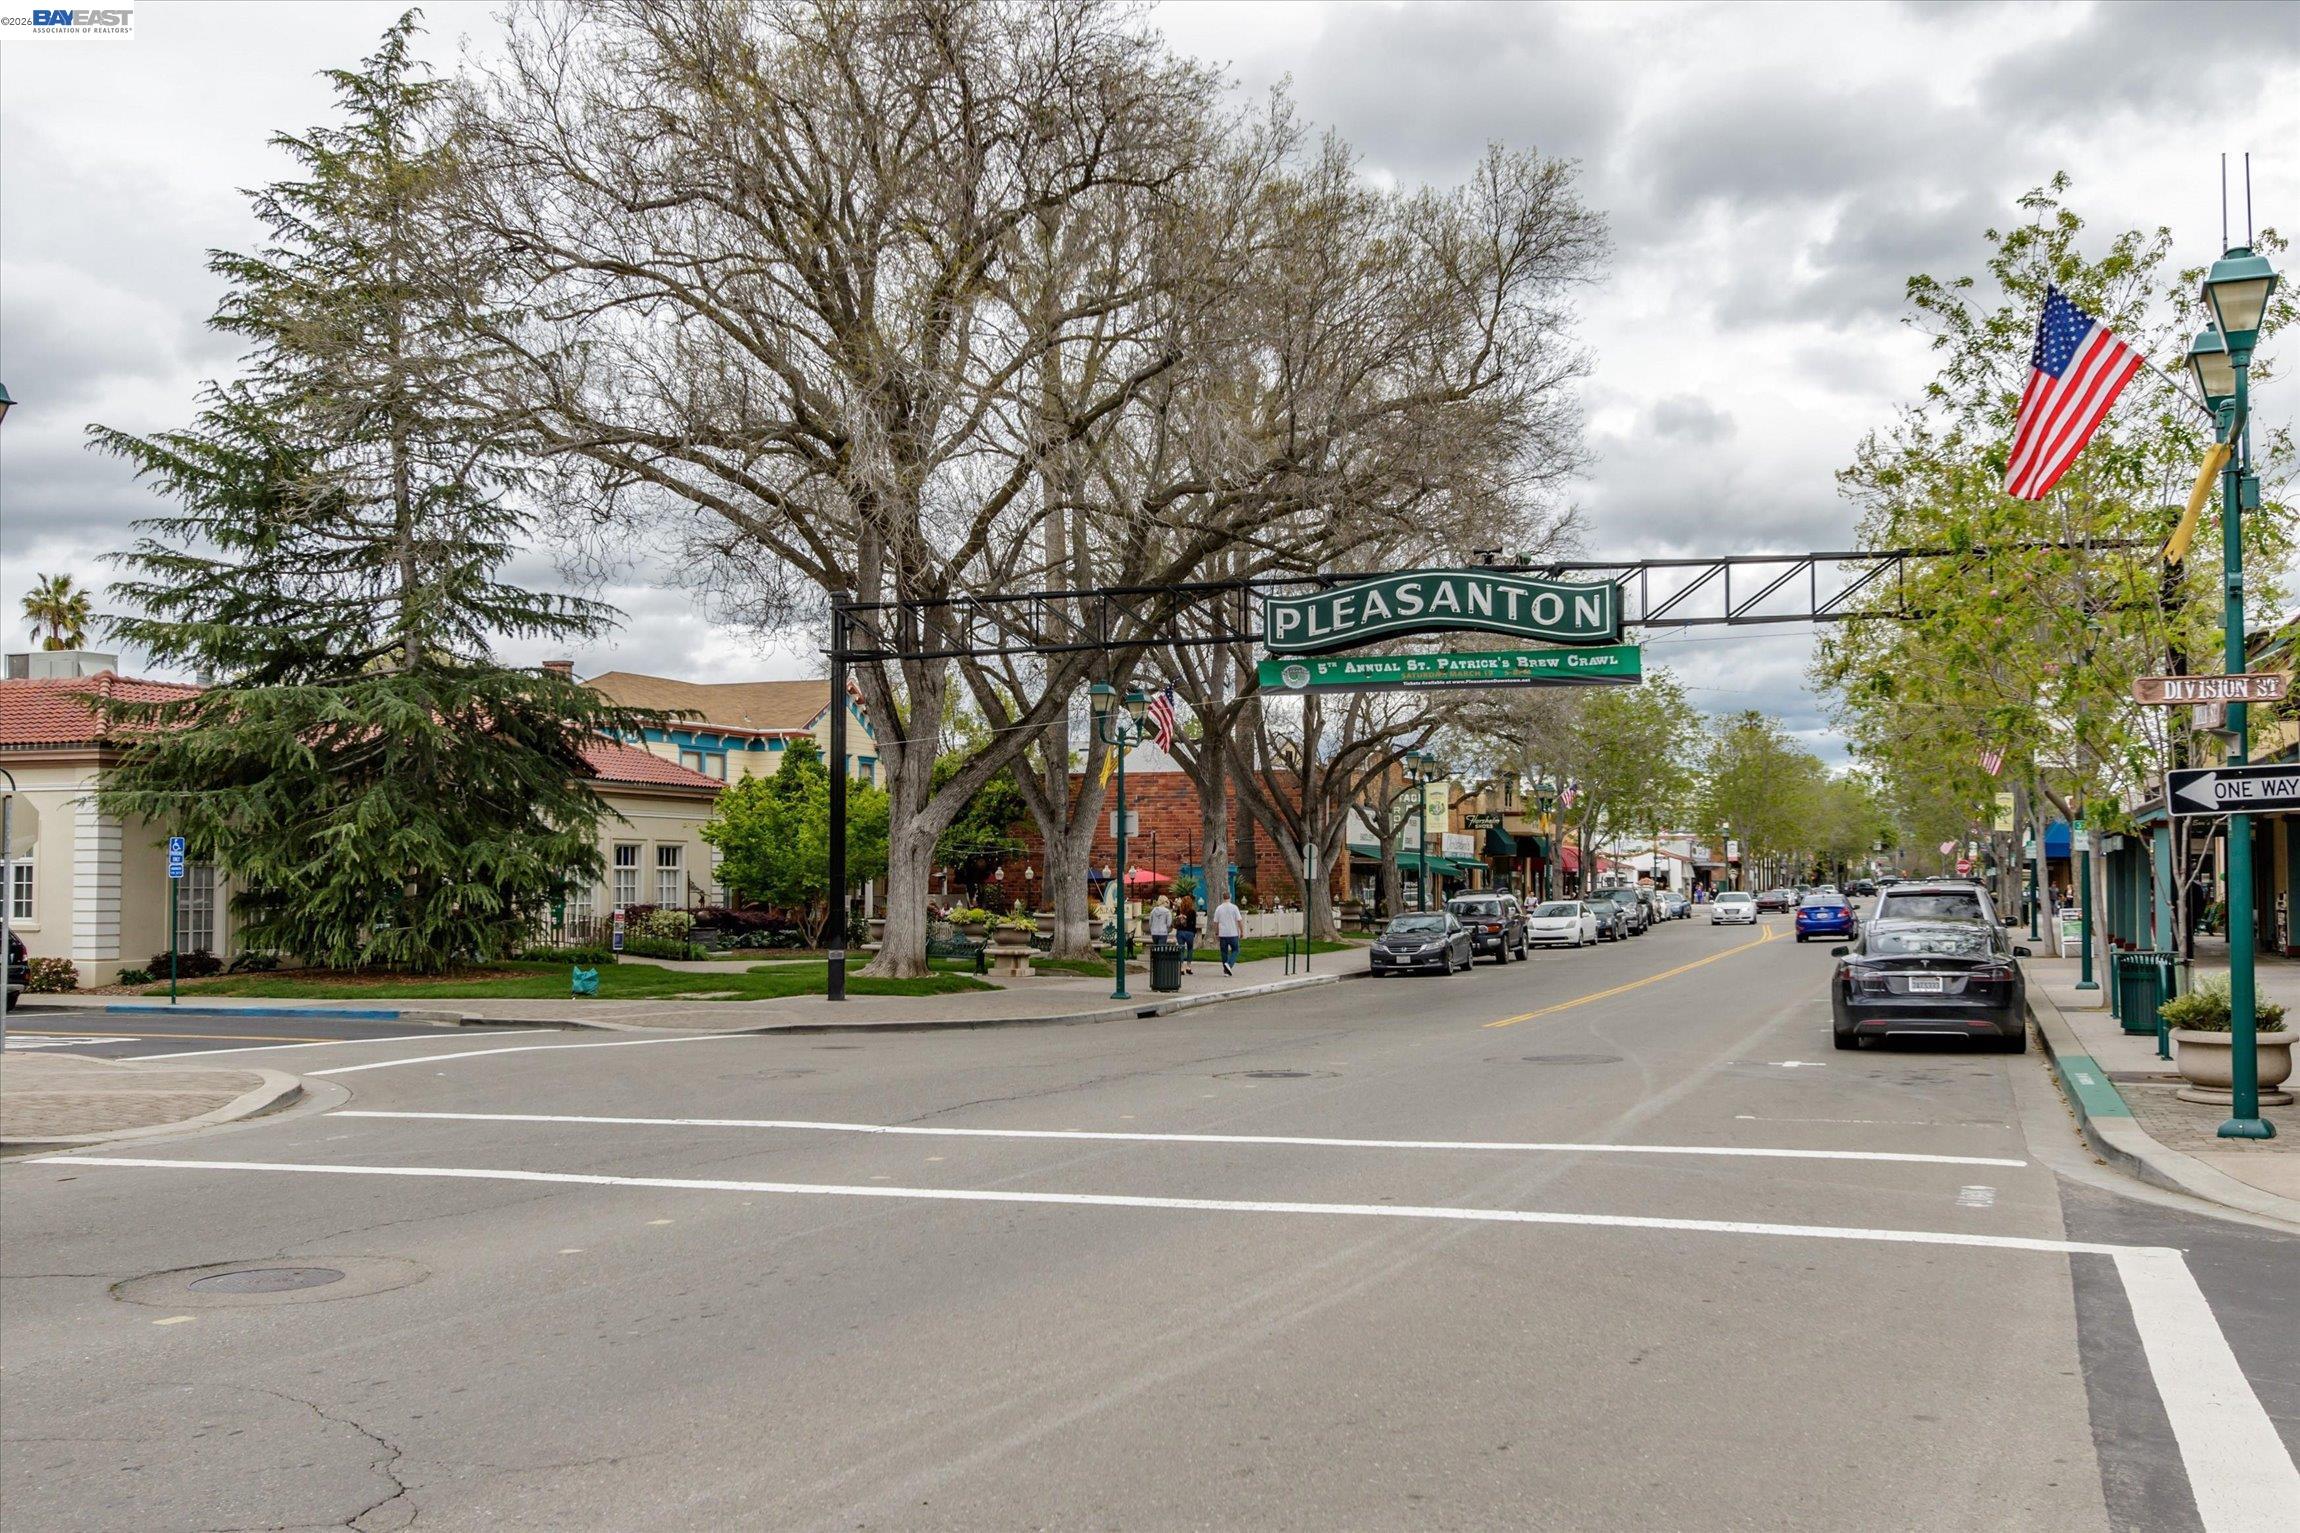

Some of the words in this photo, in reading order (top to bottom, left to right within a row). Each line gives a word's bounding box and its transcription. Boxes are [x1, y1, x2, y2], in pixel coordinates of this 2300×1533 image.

[1275, 580, 1601, 640] PLEASANTON
[2163, 677, 2249, 700] DIVISION
[2214, 781, 2253, 799] ONE
[2261, 778, 2299, 797] WAY
